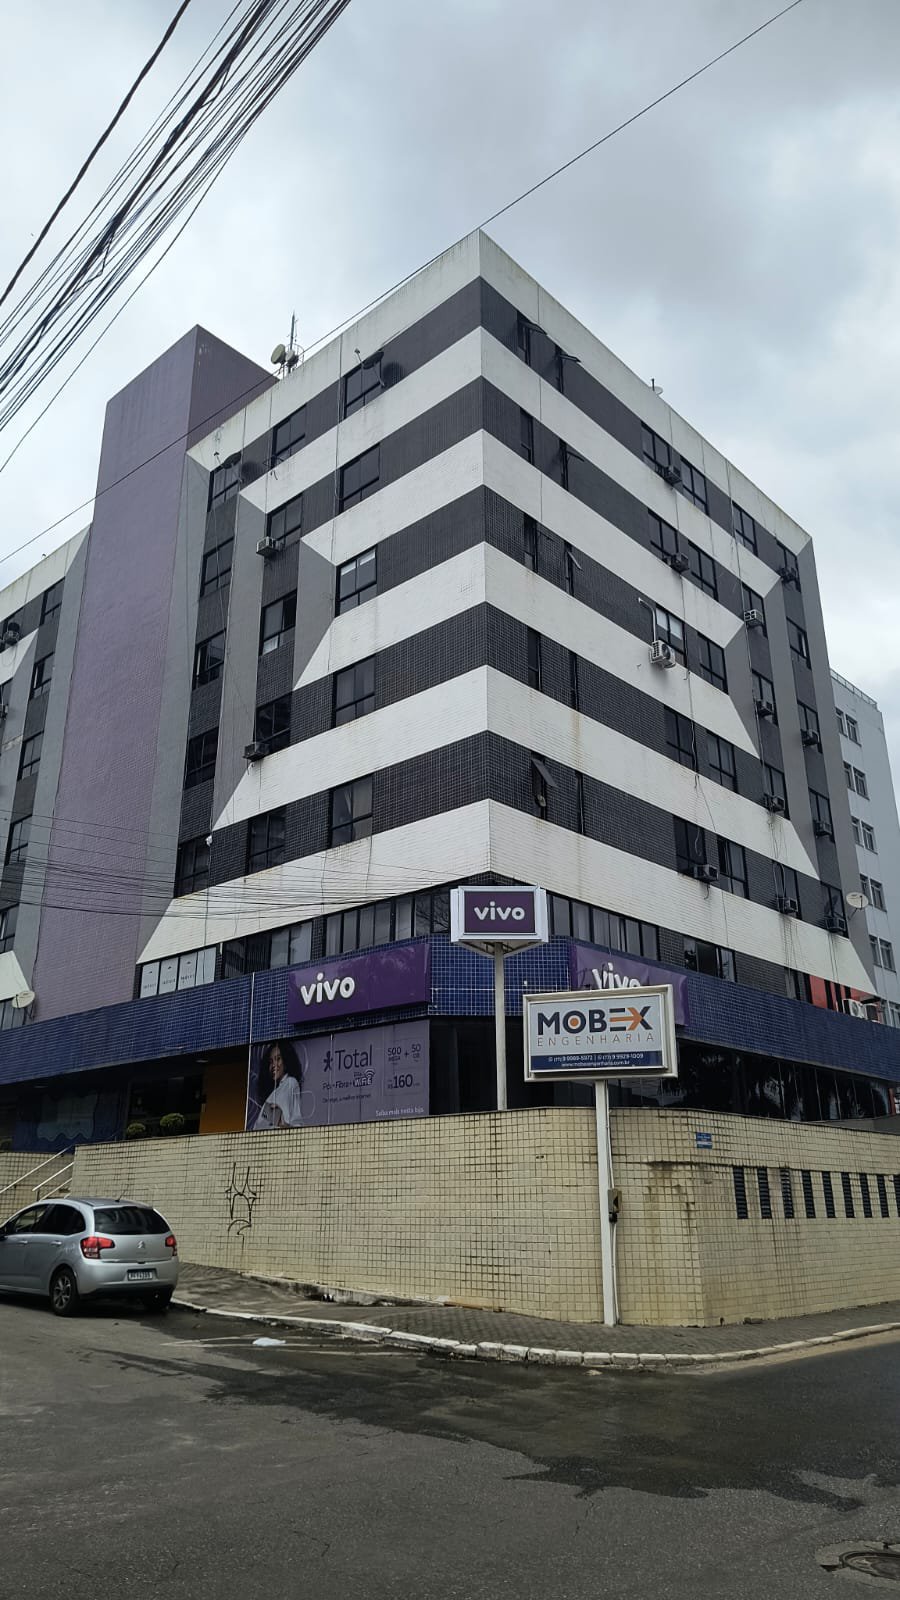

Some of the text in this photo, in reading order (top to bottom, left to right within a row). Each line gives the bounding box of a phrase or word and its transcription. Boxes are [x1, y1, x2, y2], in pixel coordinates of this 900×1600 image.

[473, 900, 526, 921] vivo
[300, 972, 356, 1006] vivo
[537, 1005, 653, 1035] MOBEX
[387, 1046, 402, 1056] 500
[411, 1043, 422, 1053] 50
[537, 1031, 655, 1047] ENGENHARIA
[334, 1043, 373, 1071] Total
[393, 1073, 413, 1089] 160
